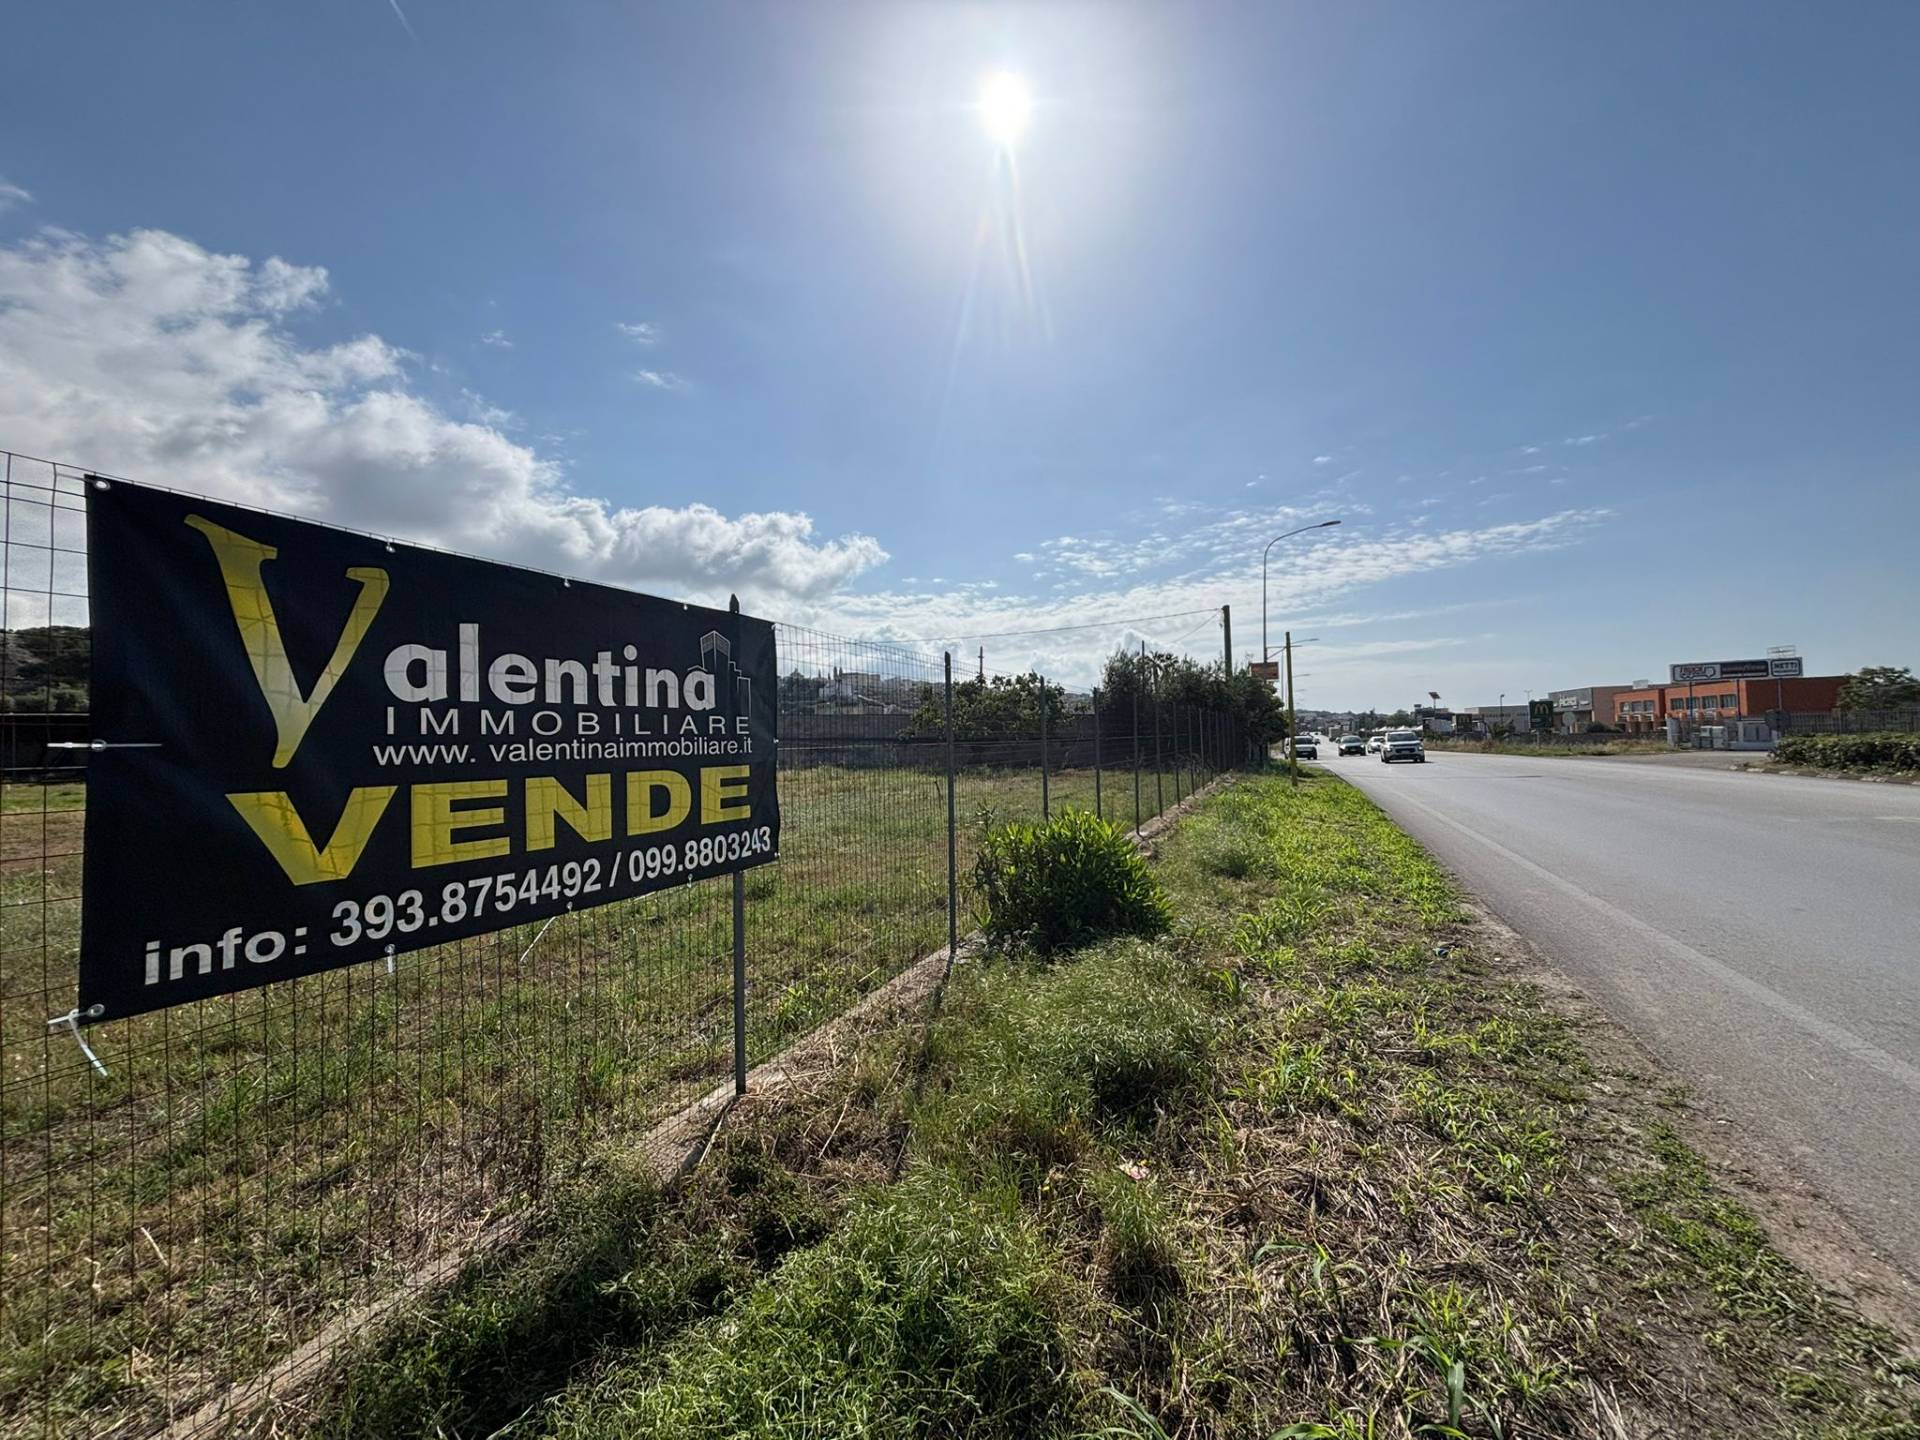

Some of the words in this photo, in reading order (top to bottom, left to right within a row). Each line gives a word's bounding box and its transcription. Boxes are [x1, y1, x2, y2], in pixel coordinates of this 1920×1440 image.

[373, 741, 477, 766] www.
[489, 736, 753, 763] valentinaimmobiliare.it
[386, 706, 750, 736] IMMOBILIARE
[225, 764, 752, 886] VENDE
[144, 926, 308, 987] info:
[329, 857, 602, 947] 393.8754492
[609, 851, 622, 888] /
[628, 825, 772, 883] 099.8803243
